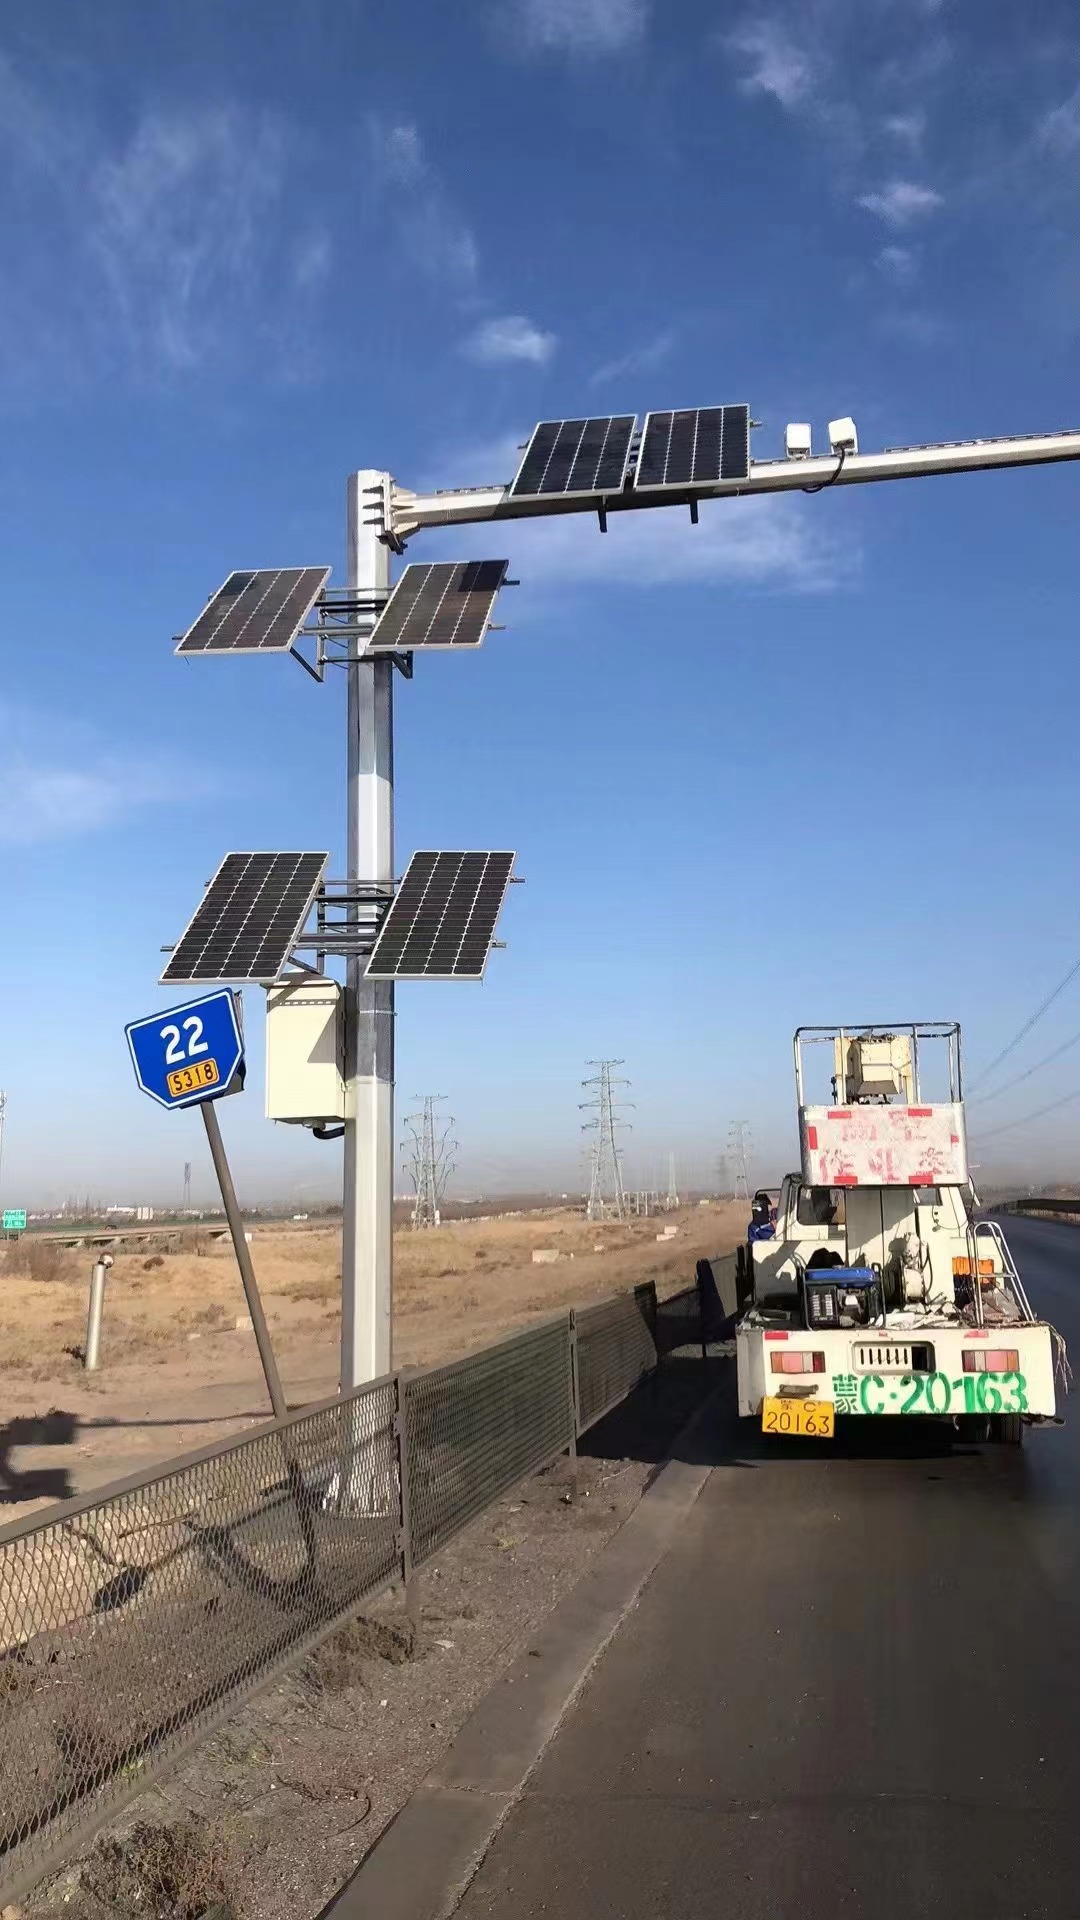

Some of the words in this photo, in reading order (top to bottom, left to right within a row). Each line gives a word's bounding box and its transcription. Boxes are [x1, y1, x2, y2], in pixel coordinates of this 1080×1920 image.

[160, 1016, 208, 1064] 22
[173, 1064, 213, 1091] S318
[766, 1411, 829, 1434] 20163
